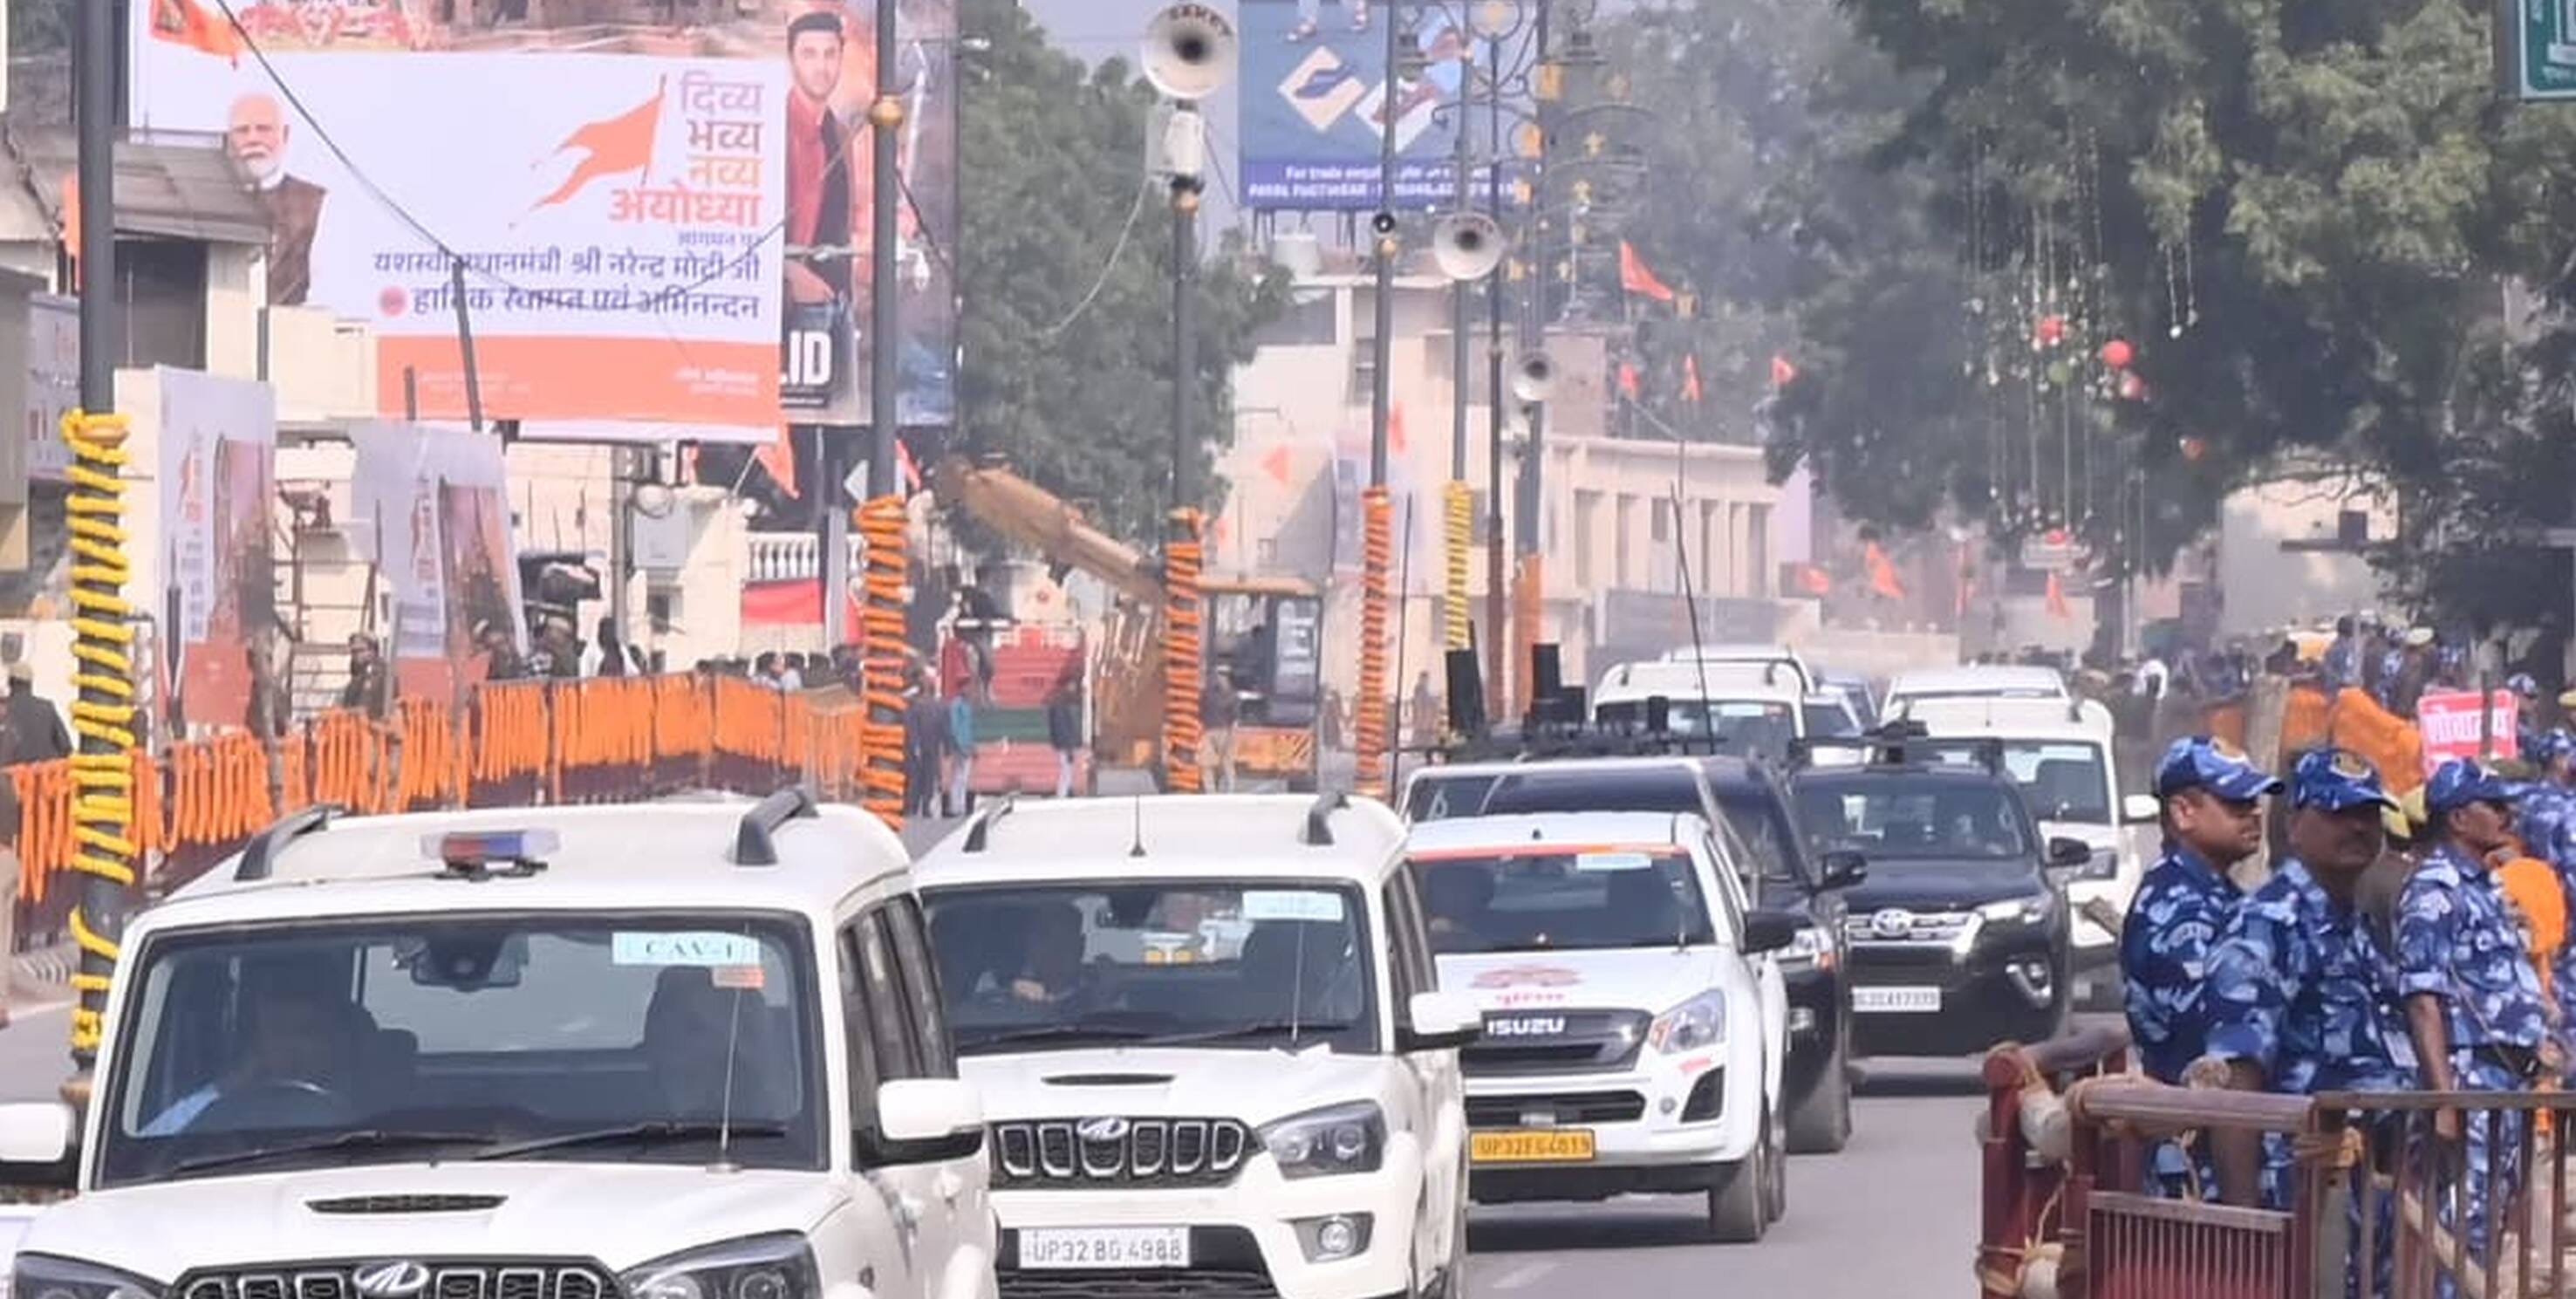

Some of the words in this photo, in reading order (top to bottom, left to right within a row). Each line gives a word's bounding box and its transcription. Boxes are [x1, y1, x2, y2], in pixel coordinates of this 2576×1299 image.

[680, 70, 765, 114] दिव्य
[687, 120, 764, 153] भव्य
[687, 154, 764, 188] नव्य
[608, 178, 763, 227] अयोध्या
[571, 245, 601, 275] श्री
[608, 246, 666, 278] नरेन्द्र
[673, 249, 723, 279] मोदी
[780, 330, 832, 385] ID
[1487, 1017, 1565, 1036] ISUZU
